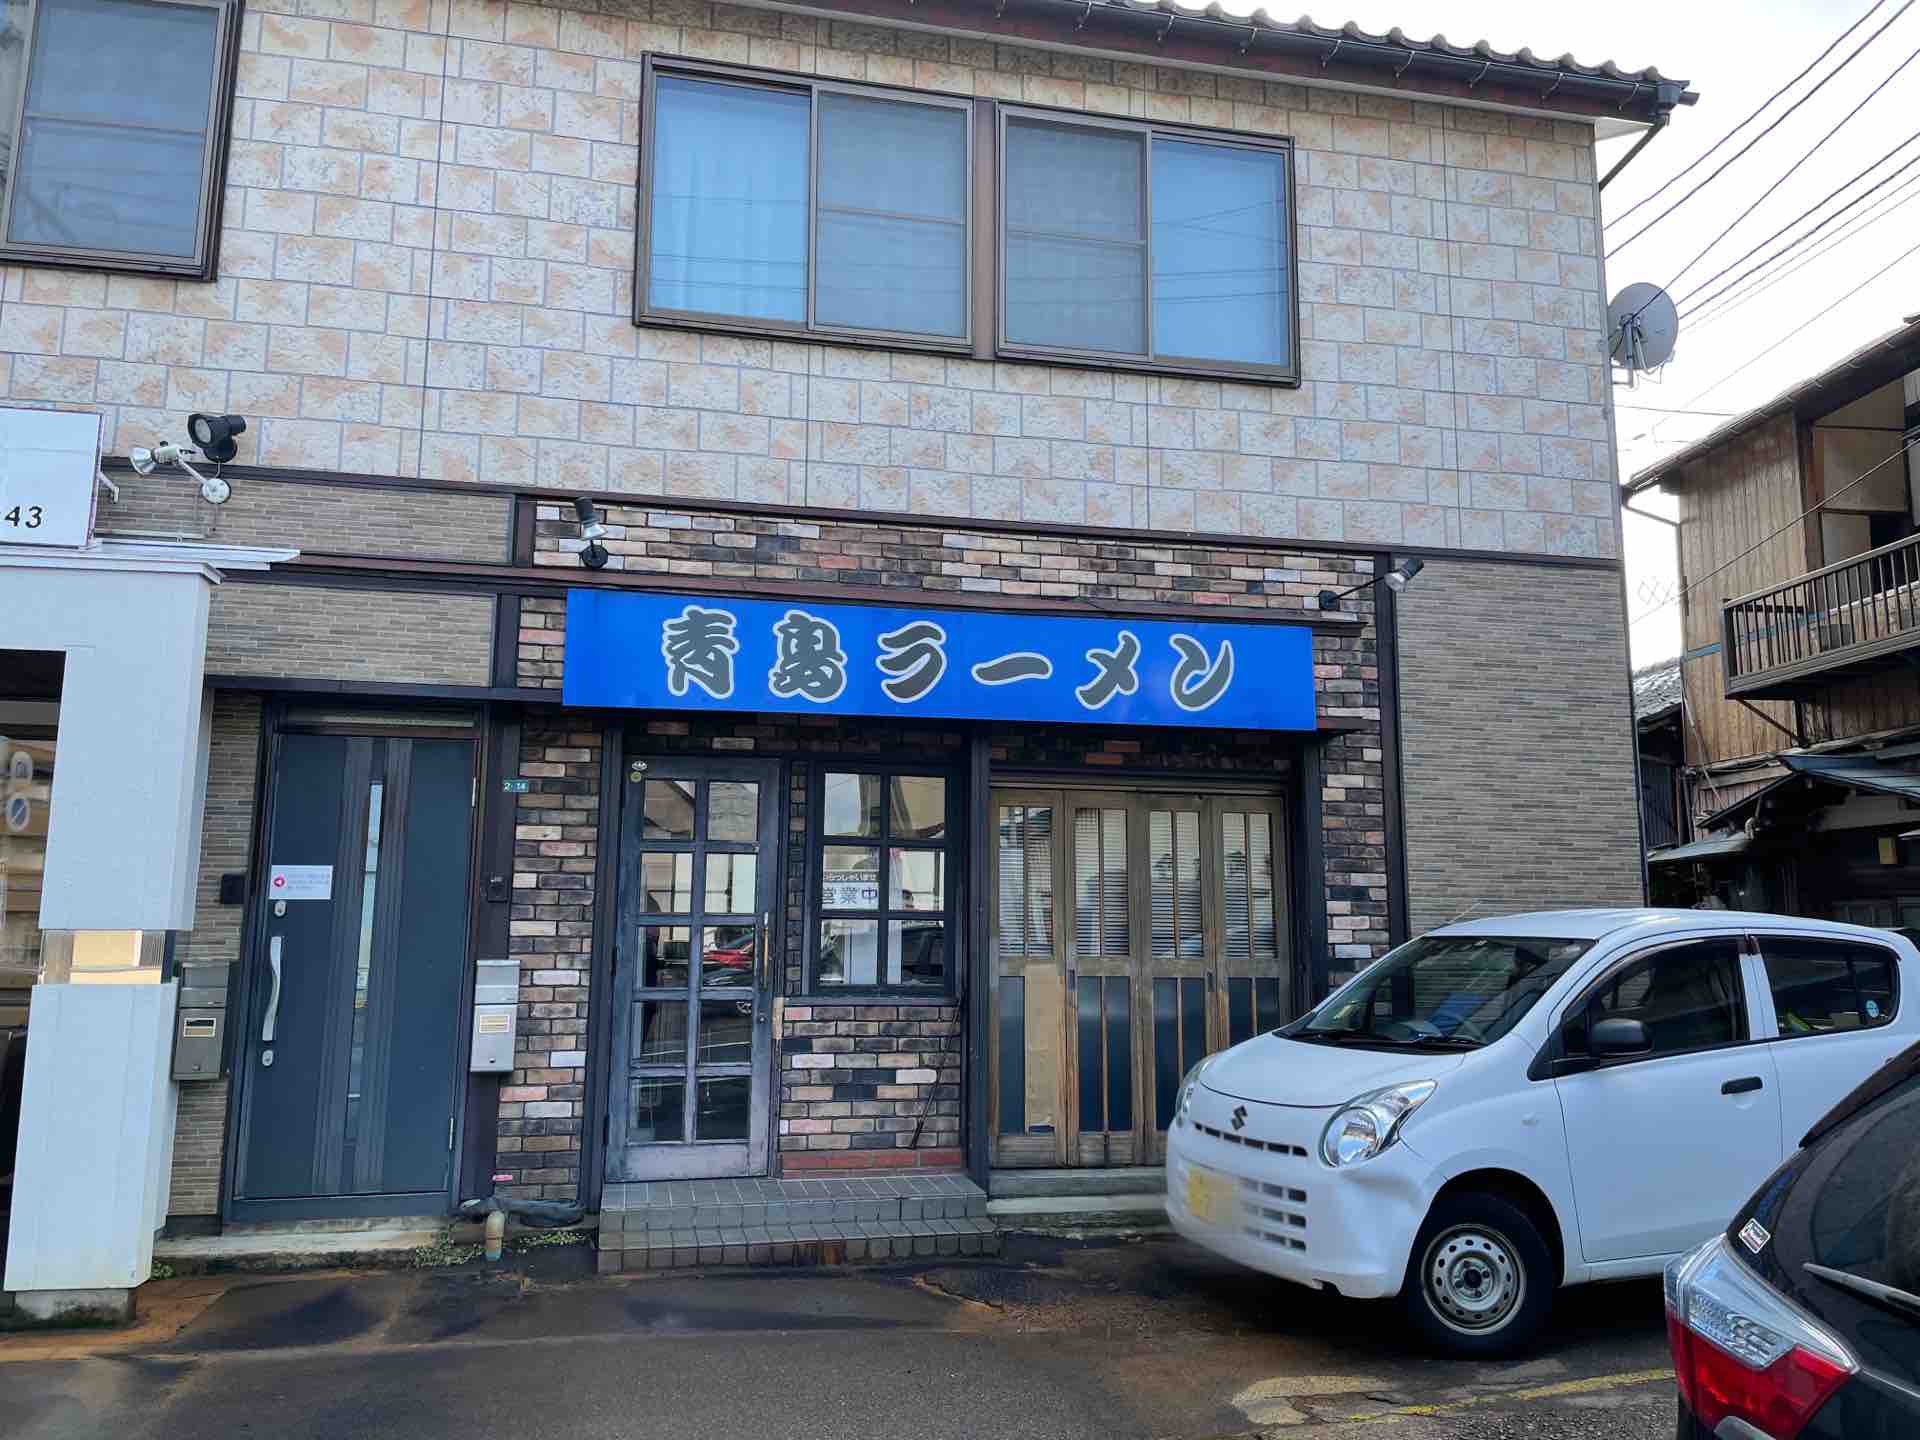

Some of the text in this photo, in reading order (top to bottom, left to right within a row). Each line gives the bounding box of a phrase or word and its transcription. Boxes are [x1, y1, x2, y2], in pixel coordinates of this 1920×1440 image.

[661, 604, 1234, 711] 青島ラーメン
